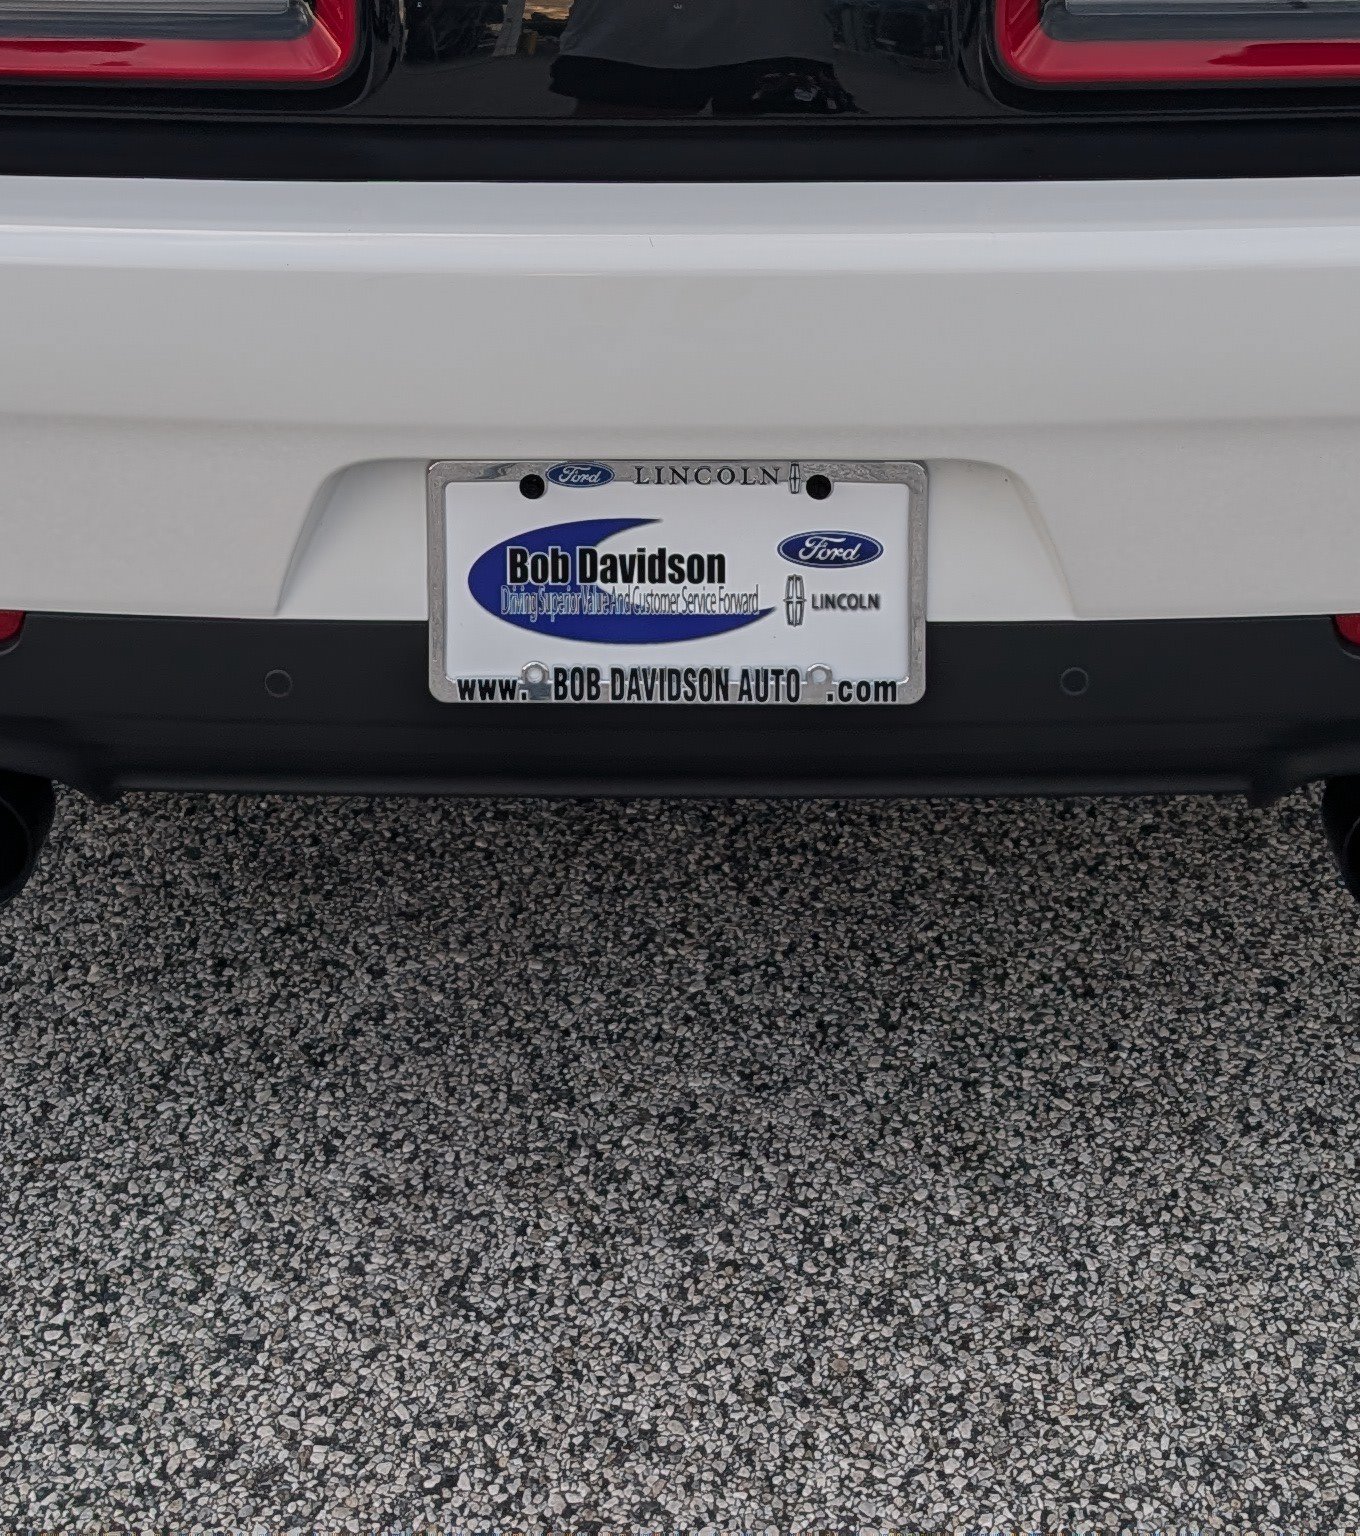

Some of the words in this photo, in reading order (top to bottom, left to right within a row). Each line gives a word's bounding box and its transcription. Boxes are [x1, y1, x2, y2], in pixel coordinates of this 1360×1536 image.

[557, 464, 603, 483] Ford
[633, 465, 781, 485] LINCOLN
[798, 535, 862, 561] Ford
[507, 547, 571, 584] Bob
[577, 547, 727, 584] Davidson
[501, 585, 539, 622] Driving
[632, 587, 681, 614] Customer
[682, 585, 717, 614] Service
[719, 584, 761, 614] Forward
[811, 593, 880, 611] LINCOLN
[457, 678, 528, 702] www.
[552, 667, 602, 702] BOB
[610, 667, 731, 703] DAVIDSON
[740, 668, 802, 703] AUTO
[826, 678, 899, 703] .com
